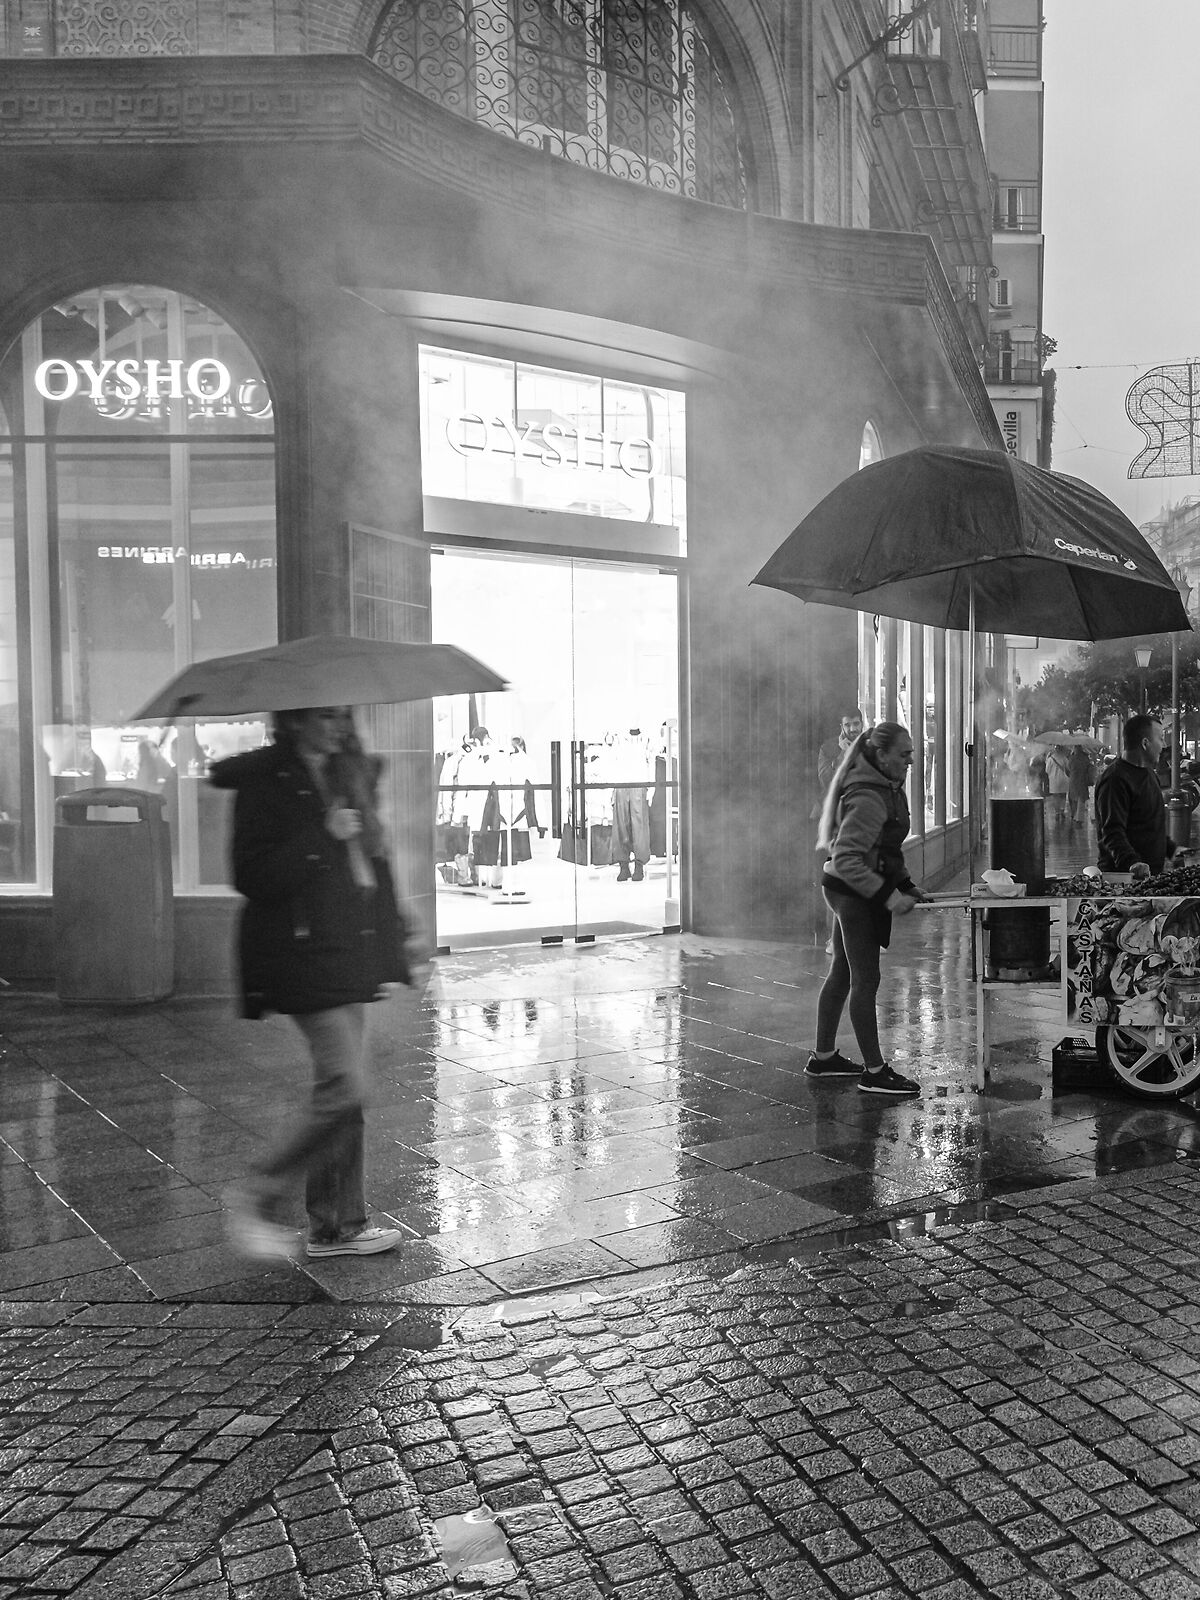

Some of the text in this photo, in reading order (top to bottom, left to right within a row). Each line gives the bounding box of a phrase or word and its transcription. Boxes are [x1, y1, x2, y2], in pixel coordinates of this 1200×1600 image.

[34, 358, 231, 401] OYSHO
[446, 412, 661, 479] OYSHO
[1054, 538, 1119, 563] Caperlan
[1078, 902, 1093, 1024] CASTAÑAS
